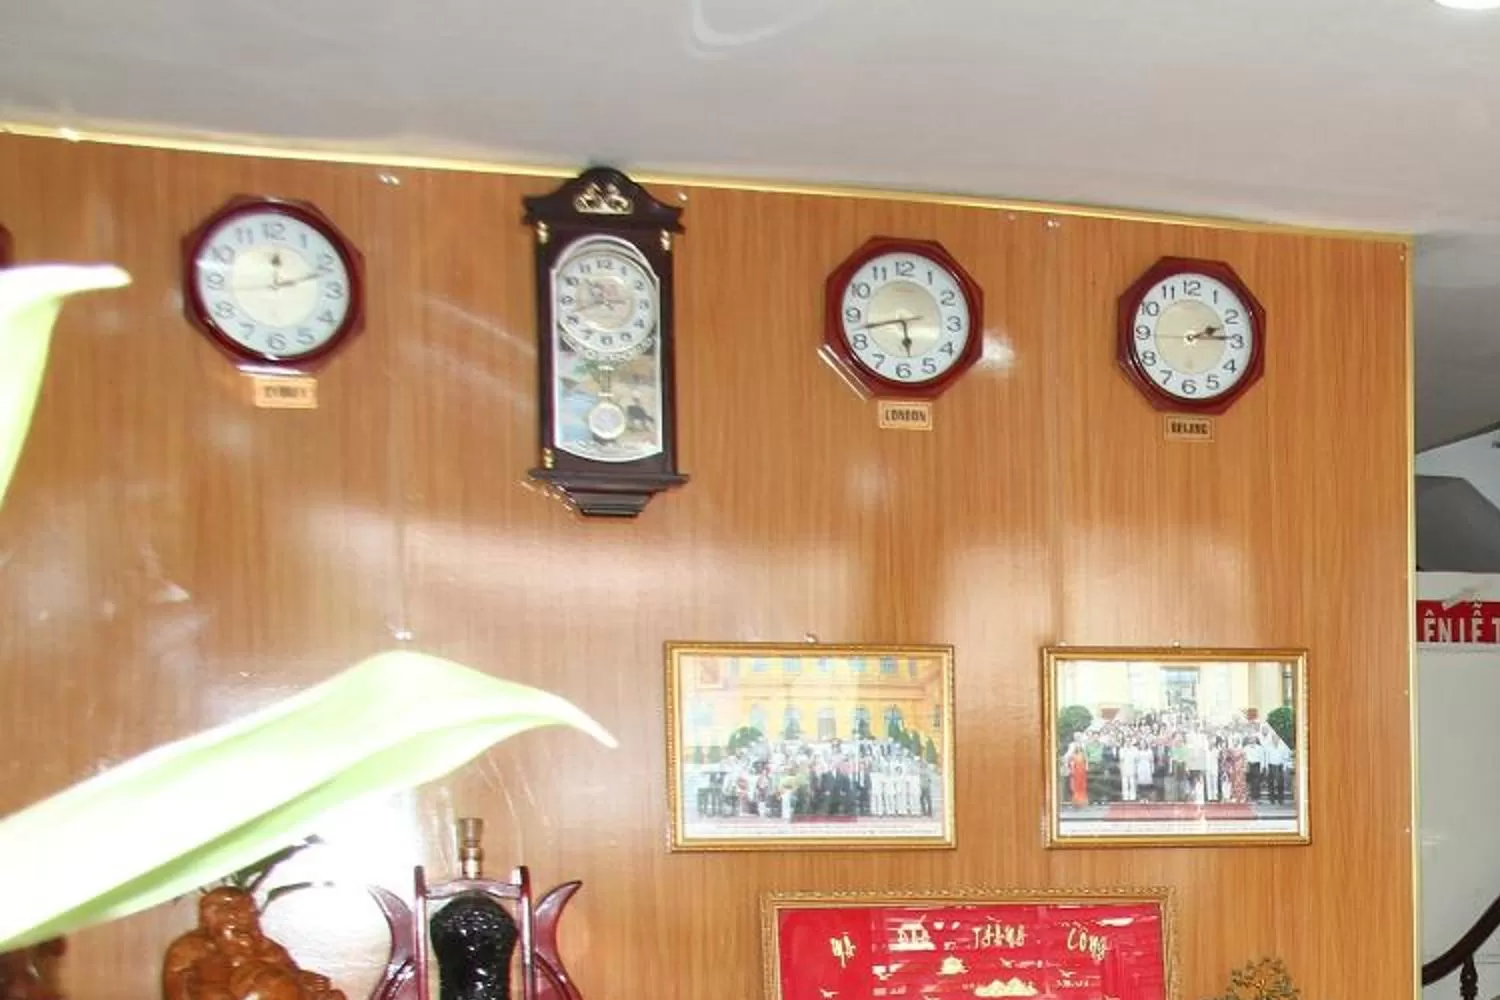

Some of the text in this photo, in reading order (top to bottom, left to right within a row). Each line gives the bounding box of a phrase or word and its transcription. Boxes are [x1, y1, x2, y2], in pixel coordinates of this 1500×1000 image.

[873, 266, 887, 280] 11
[895, 261, 915, 276] 12
[927, 269, 933, 284] 1
[851, 282, 871, 298] 10
[1162, 285, 1175, 300] 11
[1183, 280, 1201, 296] 12
[941, 291, 956, 307] 2
[1213, 289, 1218, 304] 1
[845, 307, 861, 322] 9
[1141, 300, 1159, 316] 10
[947, 316, 961, 332] 3
[1225, 309, 1239, 324] 2
[1136, 325, 1150, 340] 9
[853, 334, 868, 350] 8
[939, 342, 953, 356] 4
[1230, 334, 1244, 349] 3
[872, 354, 885, 369] 7
[922, 358, 937, 374] 5
[1142, 351, 1156, 366] 8
[1223, 359, 1237, 373] 4
[896, 363, 912, 378] 6
[1160, 370, 1172, 385] 7
[1181, 379, 1196, 394] 6
[1206, 375, 1219, 390] 5
